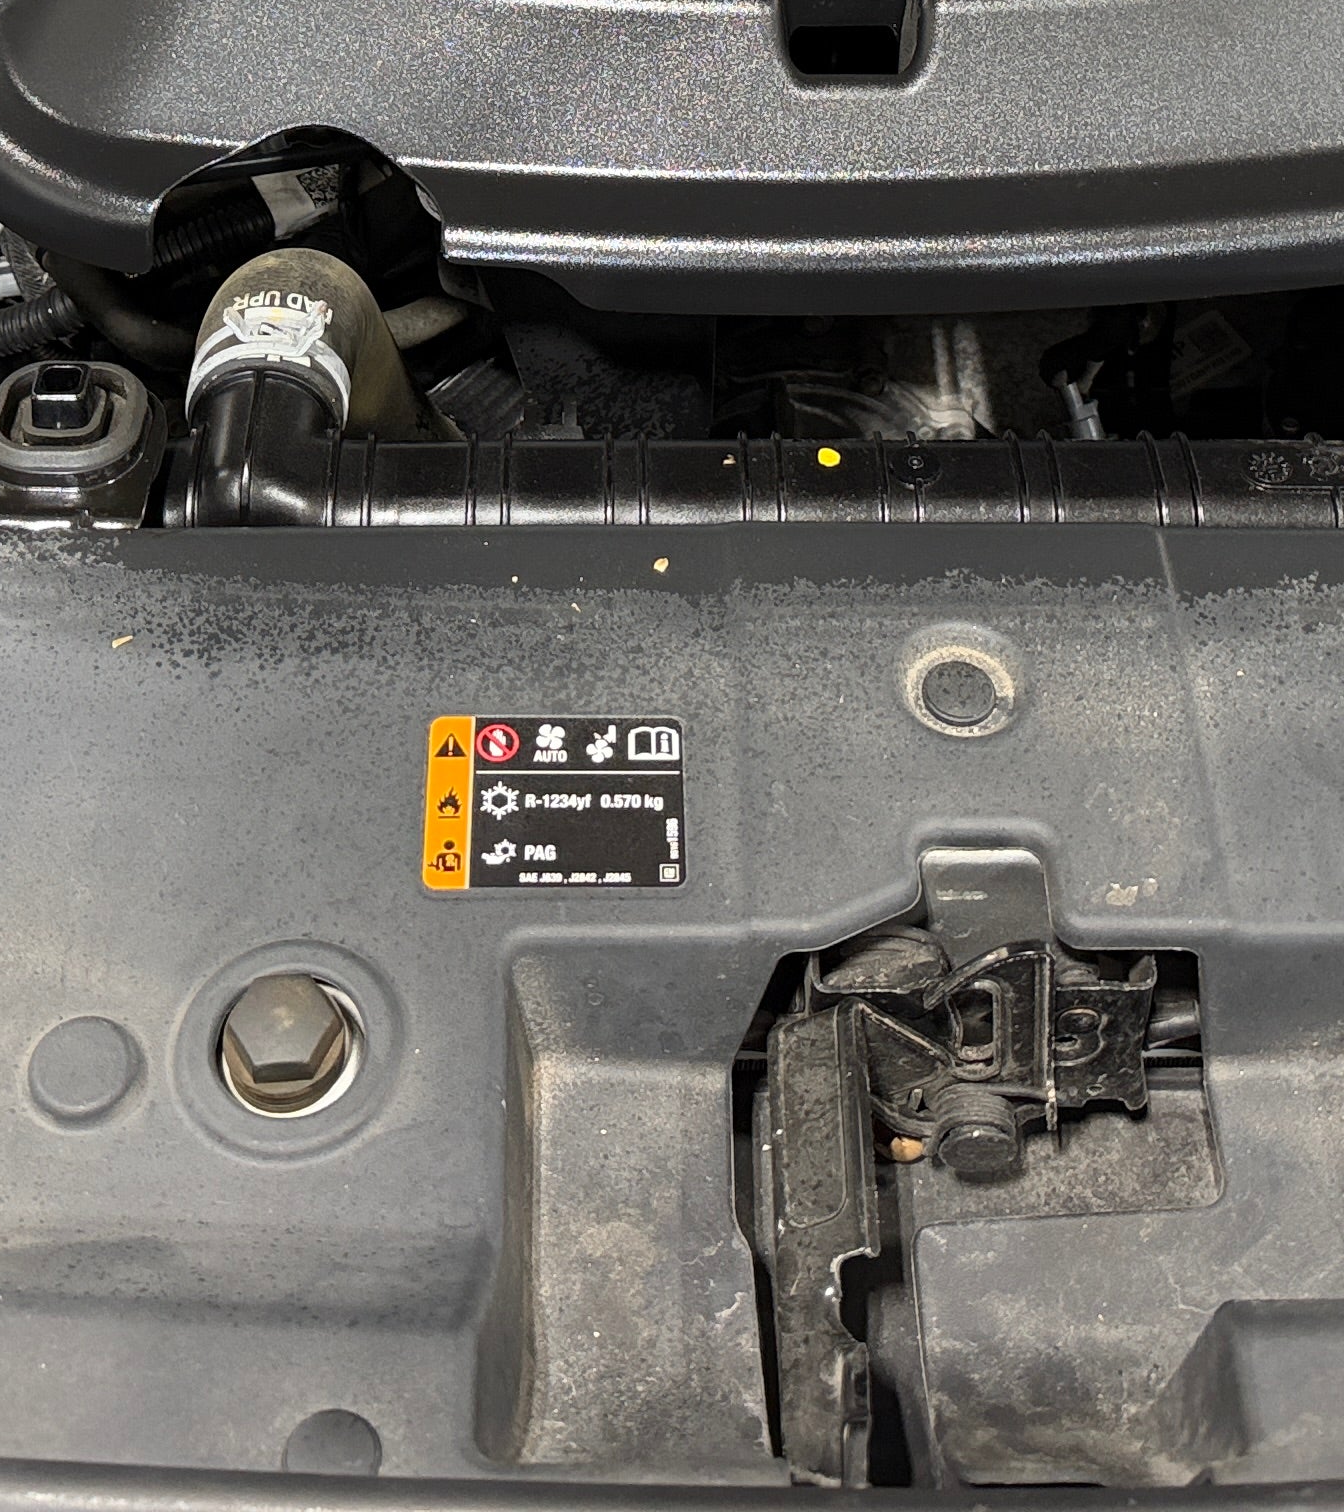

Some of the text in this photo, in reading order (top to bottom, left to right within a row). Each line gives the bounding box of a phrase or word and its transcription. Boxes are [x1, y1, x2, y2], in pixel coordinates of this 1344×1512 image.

[233, 290, 281, 311] UPR
[533, 749, 568, 763] AUTO
[524, 793, 664, 811] R-1234yf 0.570 kg
[524, 844, 557, 861] PAG
[519, 872, 538, 883] SAE
